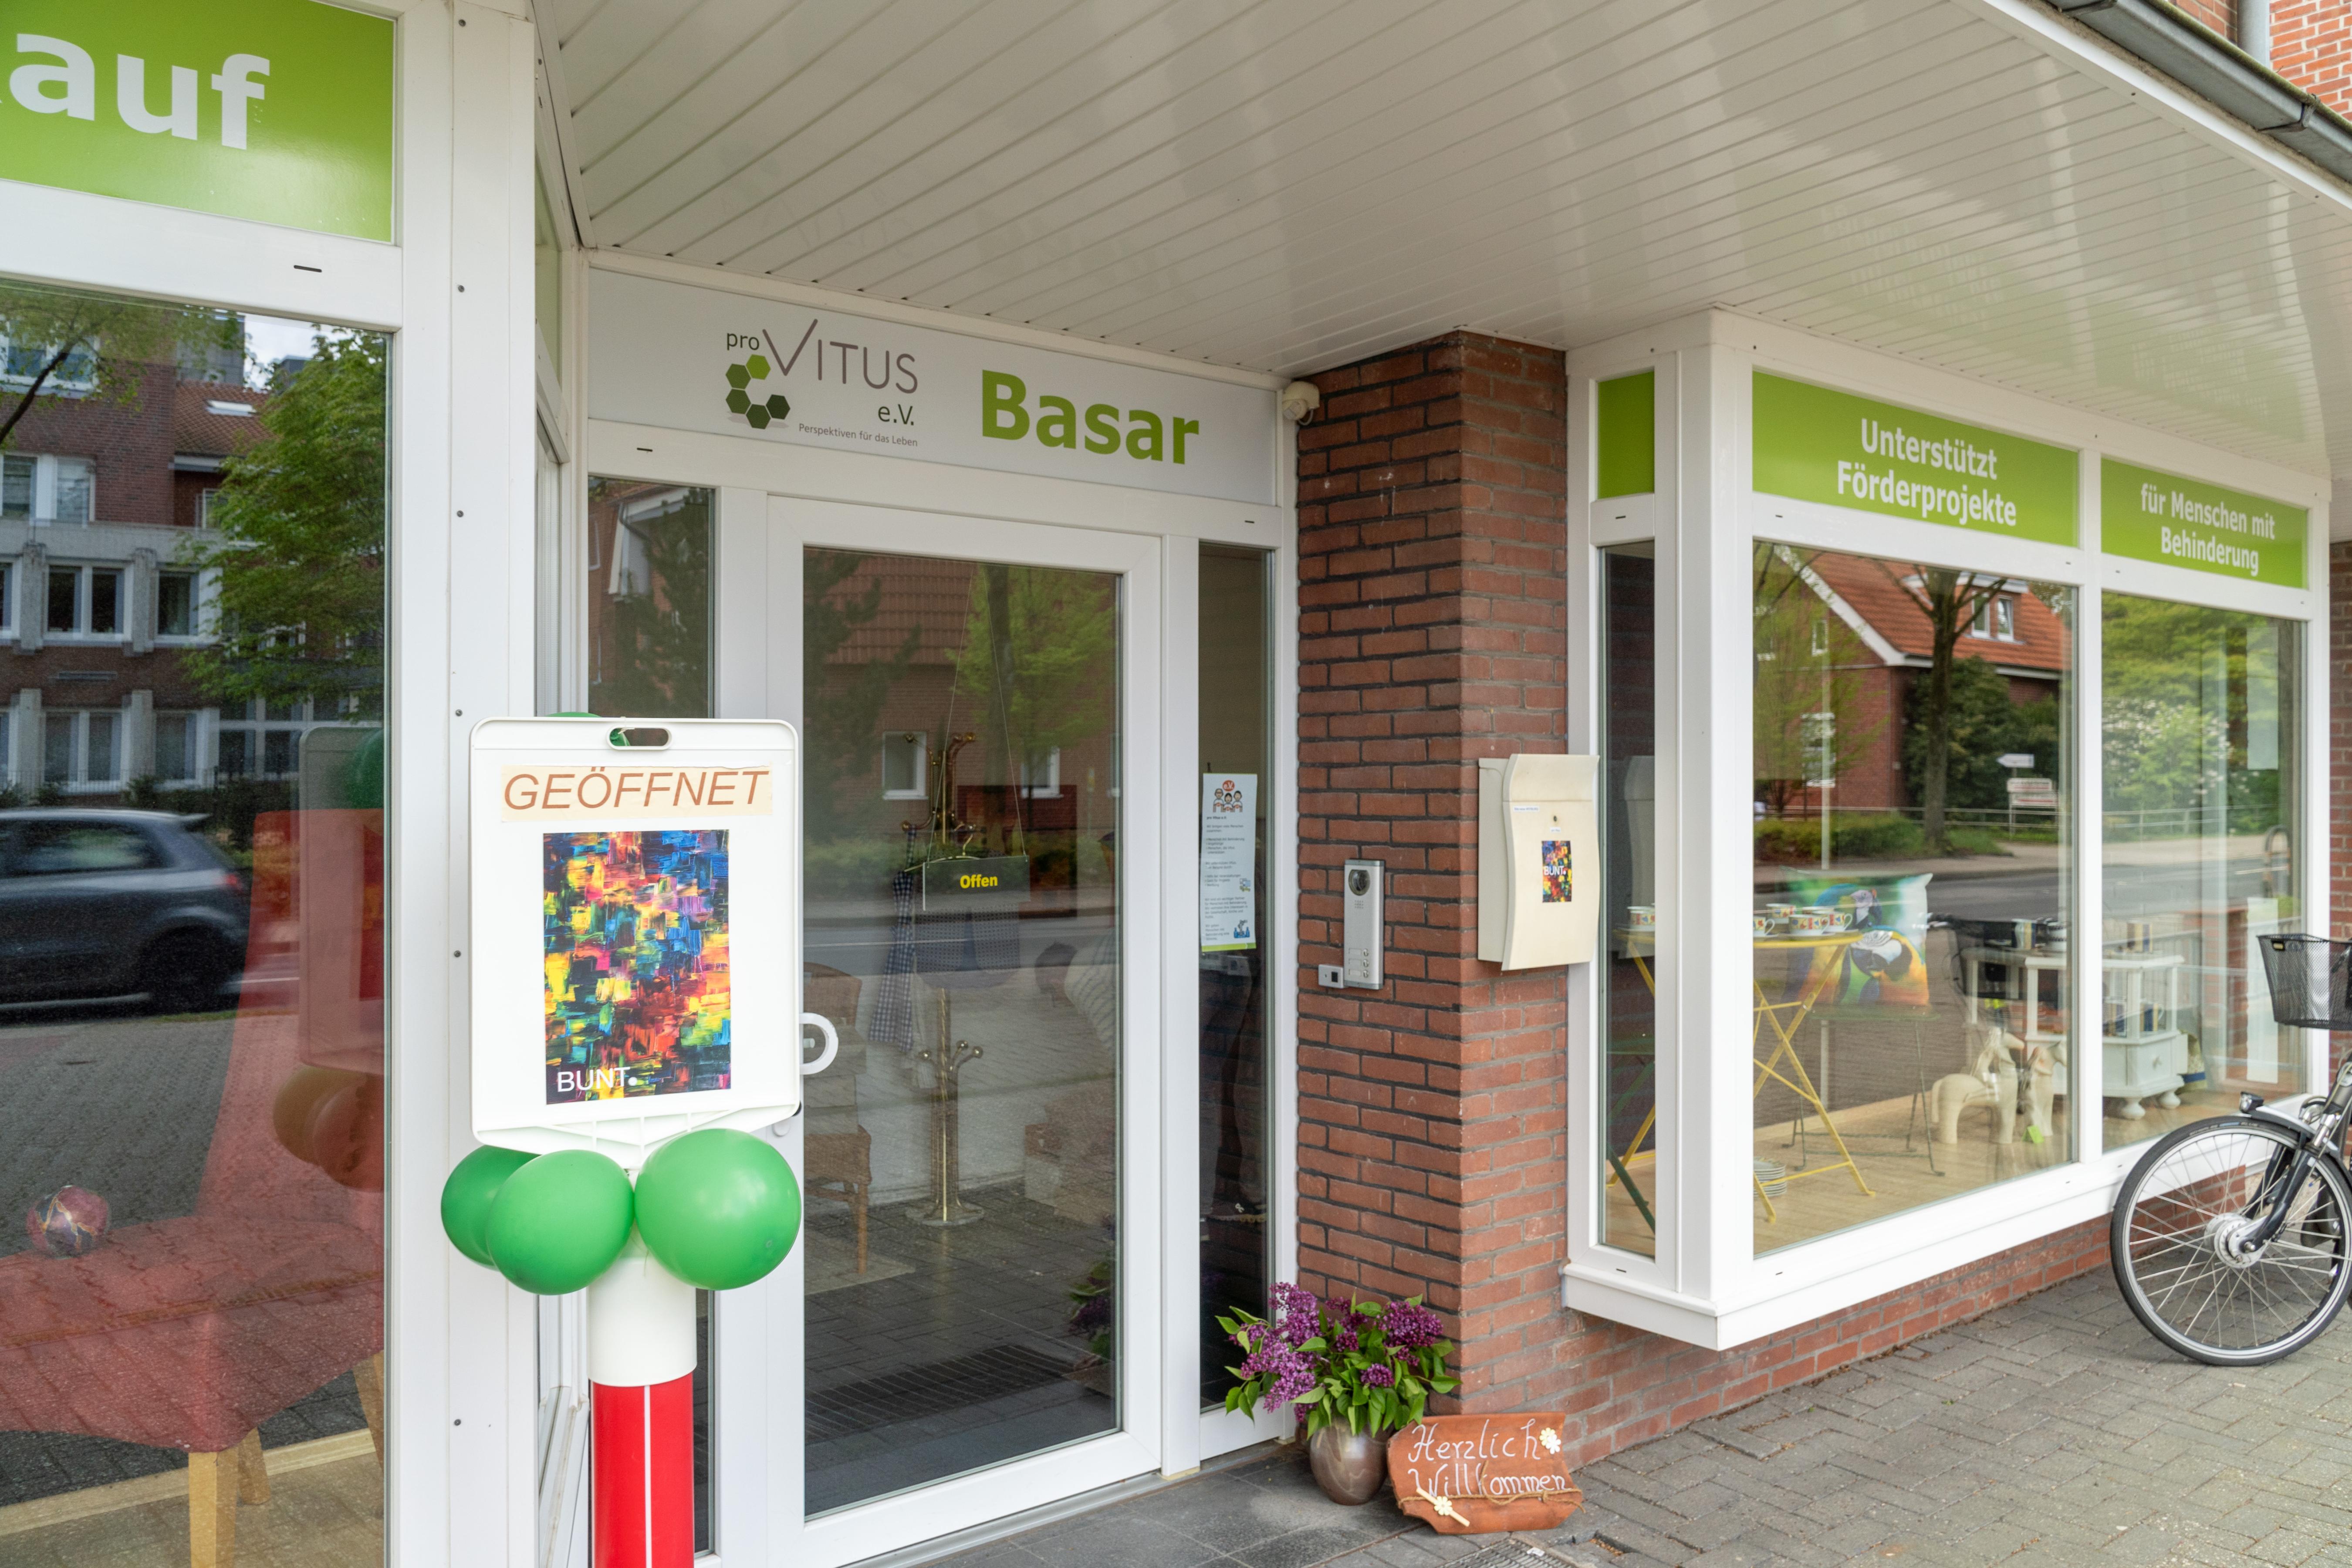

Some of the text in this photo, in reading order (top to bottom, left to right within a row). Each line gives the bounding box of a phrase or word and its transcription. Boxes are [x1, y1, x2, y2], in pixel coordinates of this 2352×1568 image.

[0, 34, 270, 150] auf
[727, 318, 918, 394] pro VITUS
[799, 423, 918, 447] Perspektiven für das Leben
[878, 404, 914, 426] e.V.
[982, 369, 1199, 464] Basar
[1861, 418, 1997, 480] Unterstützt
[1837, 460, 2016, 526] Förderprojekte
[2141, 483, 2275, 540] für Menschen mit
[2161, 526, 2259, 577] Behinderung
[504, 767, 769, 810] GEÖFFNET
[960, 874, 998, 889] Offen
[1544, 865, 1567, 876] BUNT.
[557, 1066, 638, 1092] BUNT.
[1408, 1418, 1541, 1463] Herzlich
